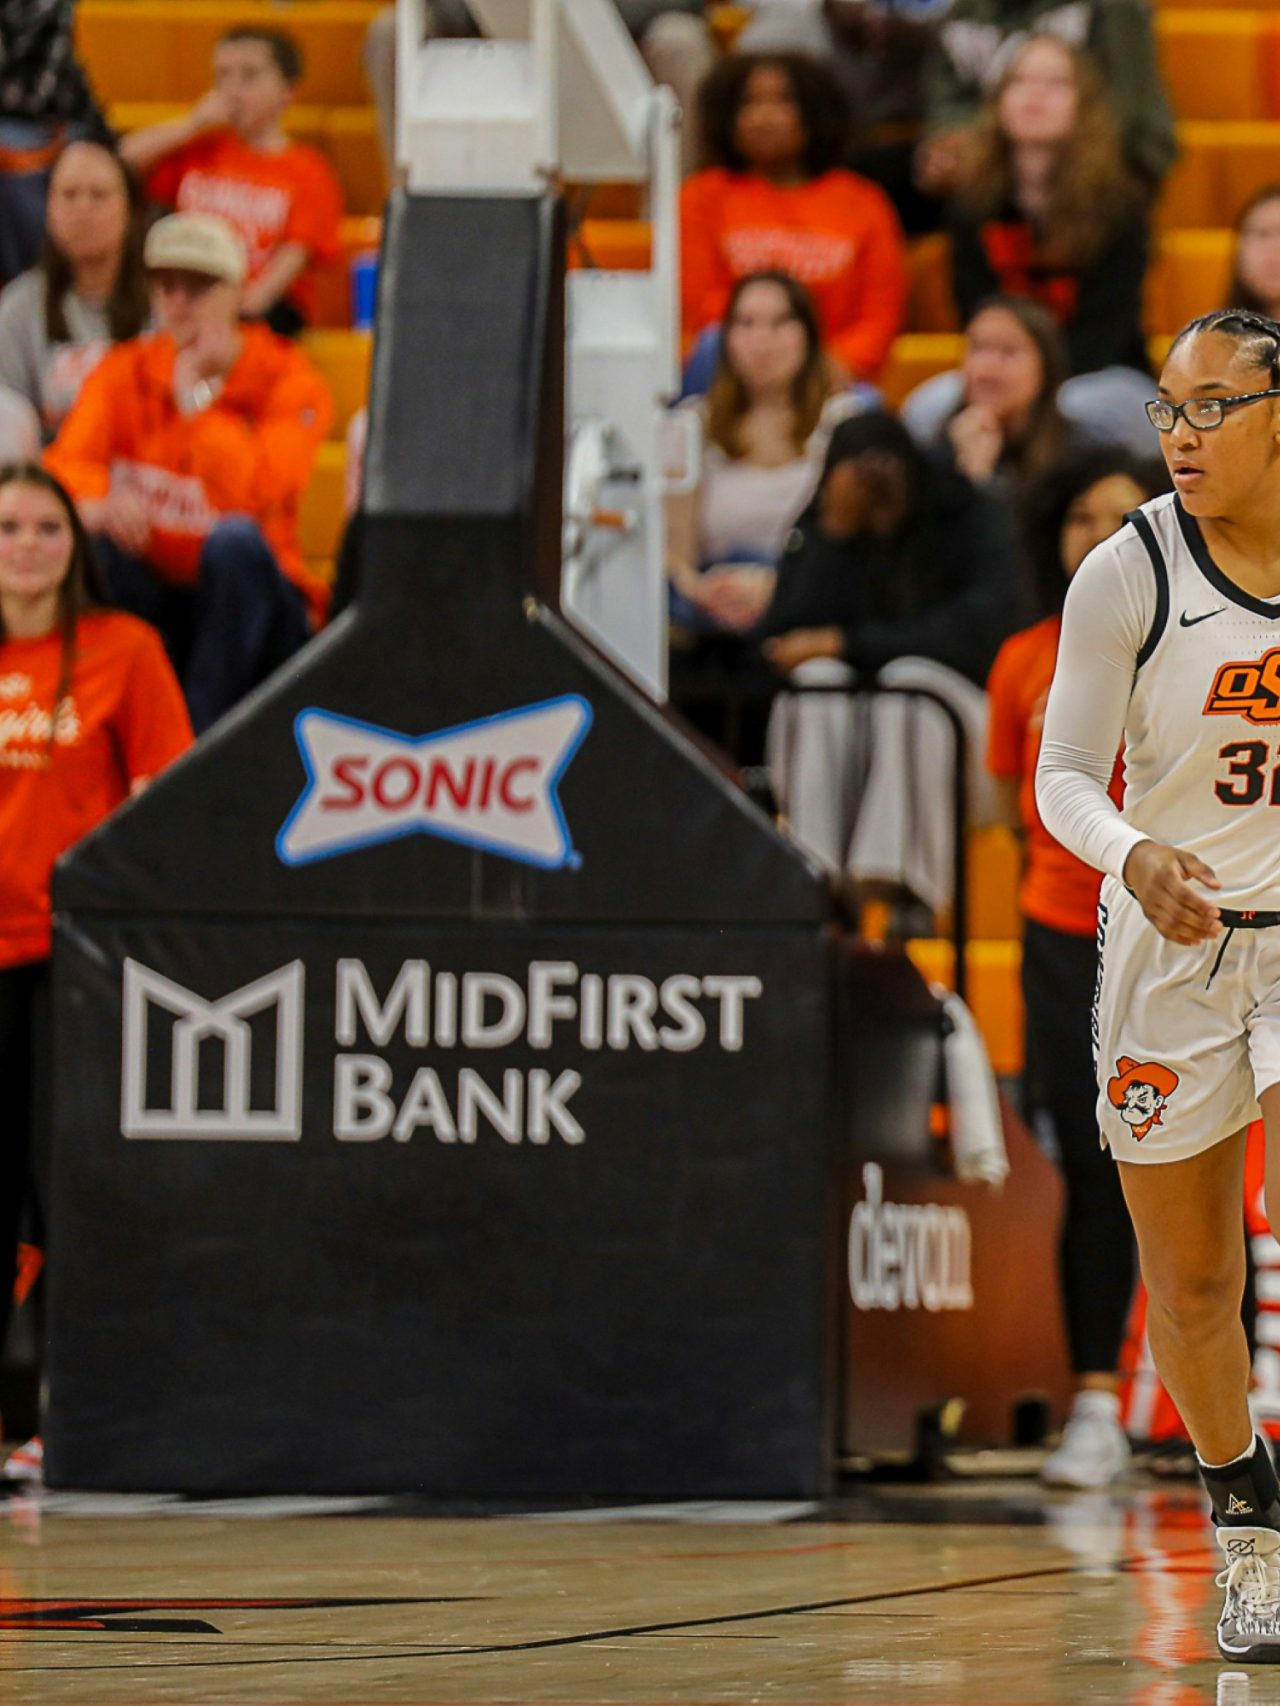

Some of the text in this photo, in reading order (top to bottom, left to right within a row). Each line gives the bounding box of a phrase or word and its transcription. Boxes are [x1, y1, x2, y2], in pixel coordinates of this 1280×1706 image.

[320, 755, 540, 815] SONIC
[335, 958, 763, 1051] MIDFIRST
[333, 1053, 586, 1145] BANK
[849, 1161, 973, 1311] devon
